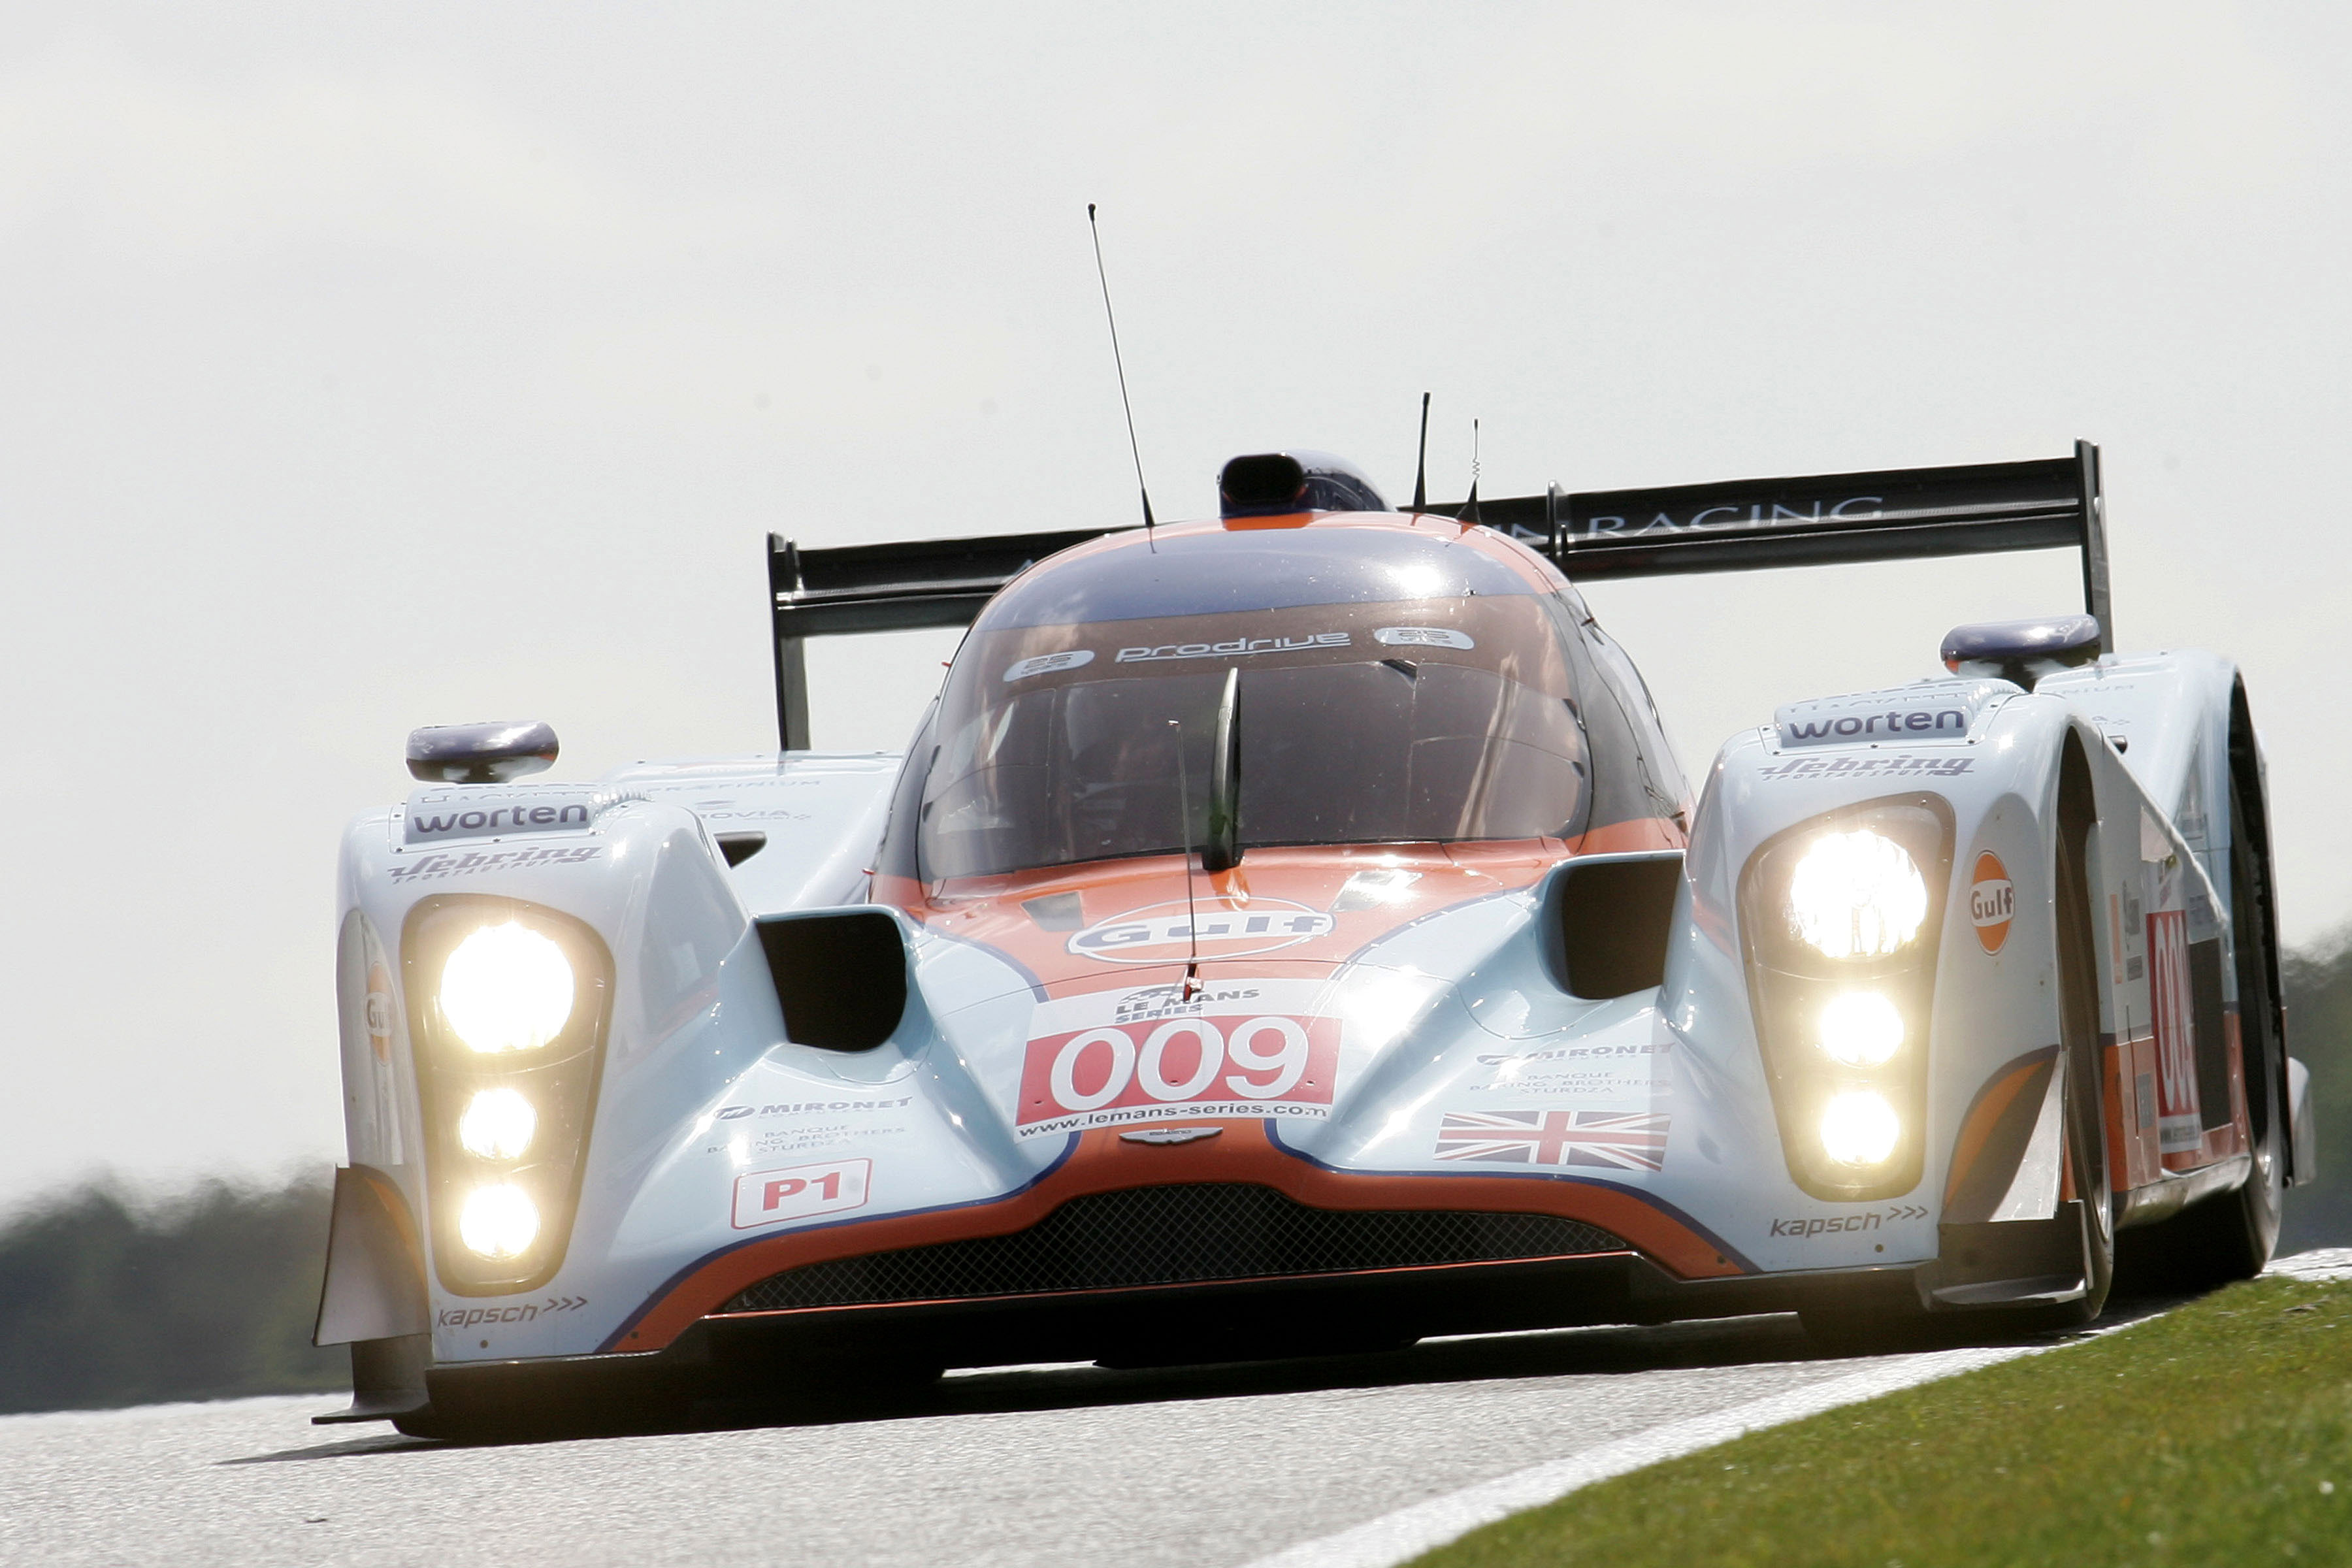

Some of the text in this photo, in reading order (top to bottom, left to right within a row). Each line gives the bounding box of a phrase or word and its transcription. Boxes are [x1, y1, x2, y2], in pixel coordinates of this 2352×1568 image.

[1588, 497, 1883, 538] RACING
[1114, 632, 1352, 663] prodrive
[1788, 710, 1964, 739] worten
[414, 804, 588, 833] worten
[1970, 887, 2013, 921] Gulf
[1076, 914, 1328, 948] Gulf
[1115, 1003, 1203, 1024] SERIES
[1116, 988, 1260, 1015] LE MANS
[1049, 1016, 1309, 1112] 009
[1525, 1043, 1676, 1060] MIRONET
[1469, 1081, 1546, 1091] BING
[759, 1097, 913, 1115] MIRONET
[1019, 1102, 1328, 1137] www.lemans-series.com
[762, 1171, 841, 1211] P1
[1770, 1212, 1881, 1239] kapsch
[437, 1303, 538, 1329] kapsch
